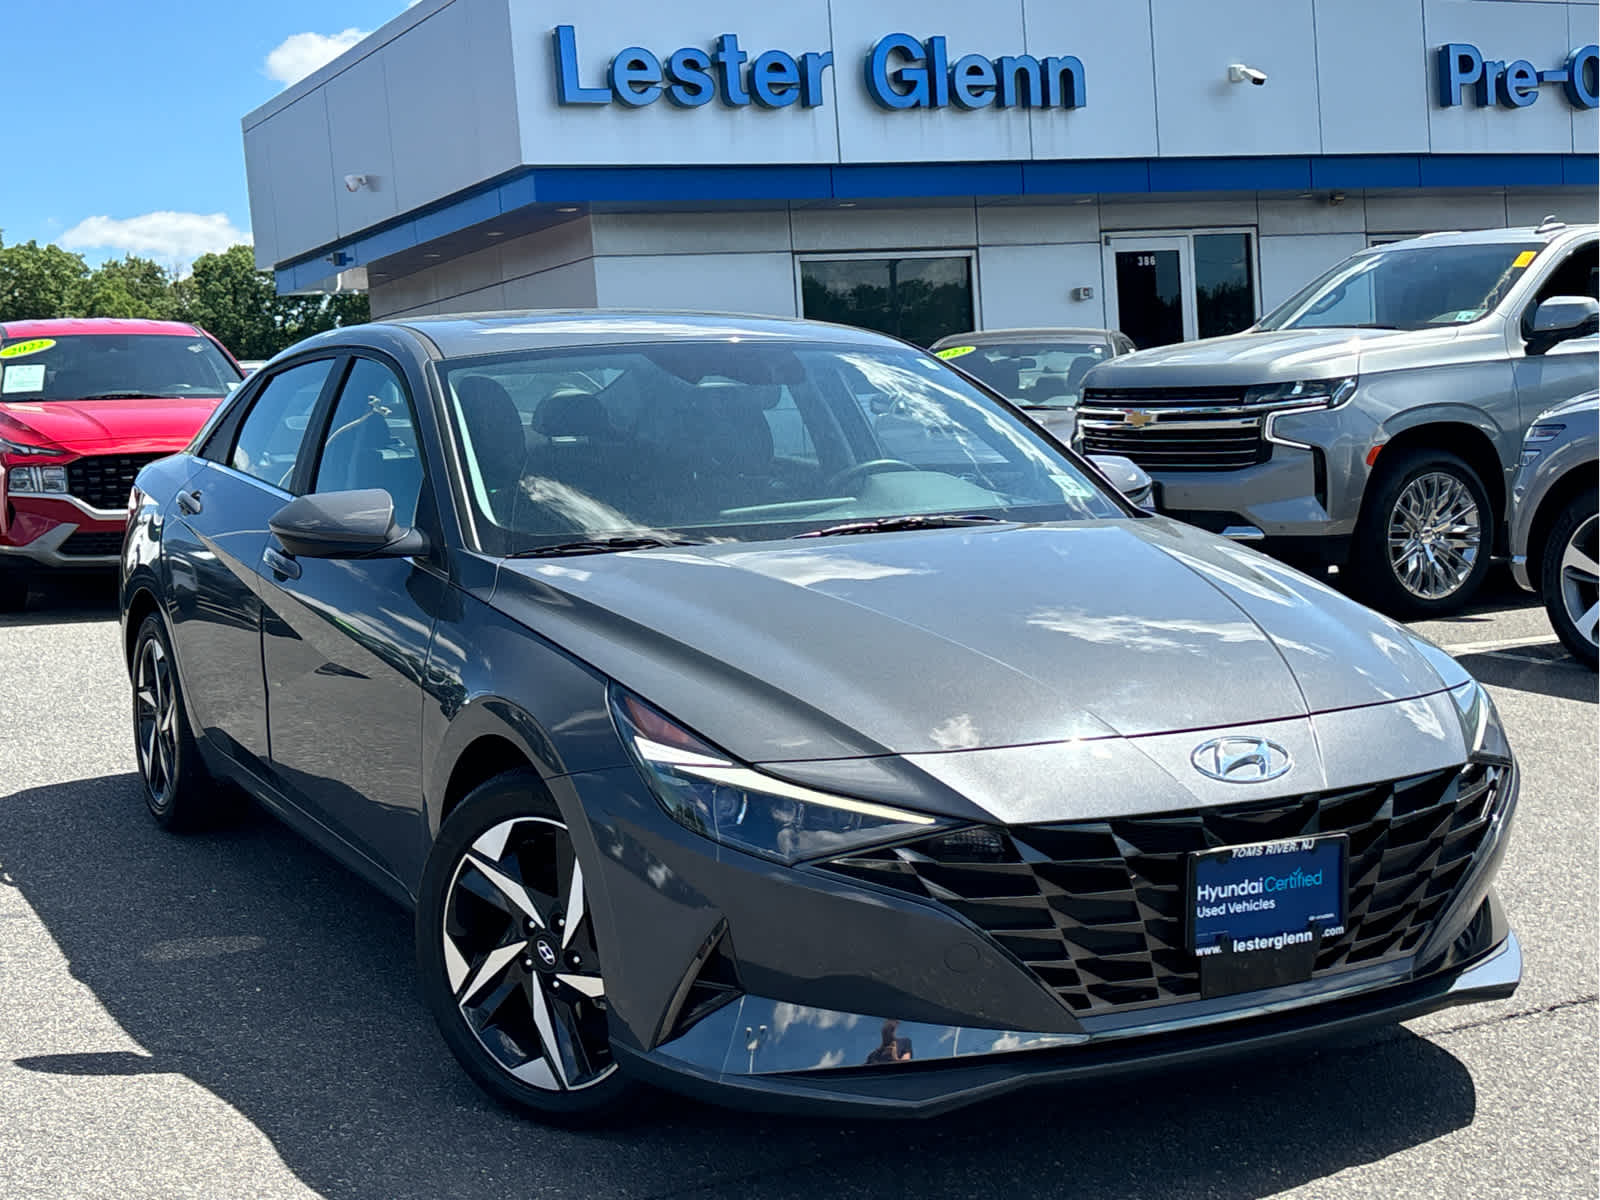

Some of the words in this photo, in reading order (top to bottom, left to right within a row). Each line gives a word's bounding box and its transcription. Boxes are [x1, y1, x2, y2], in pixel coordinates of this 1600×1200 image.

[552, 25, 834, 109] Lester
[865, 32, 1087, 110] Glenn
[1137, 256, 1156, 266] 386
[1232, 846, 1264, 858] TOMS
[1301, 838, 1315, 851] NJ
[1197, 877, 1263, 903] Hyundai
[1264, 866, 1323, 892] Certified
[1197, 903, 1226, 918] Used
[1228, 899, 1276, 914] Vehicles
[1195, 946, 1222, 957] www.
[1233, 931, 1313, 953] lesterglenn
[1321, 926, 1345, 938] .com
